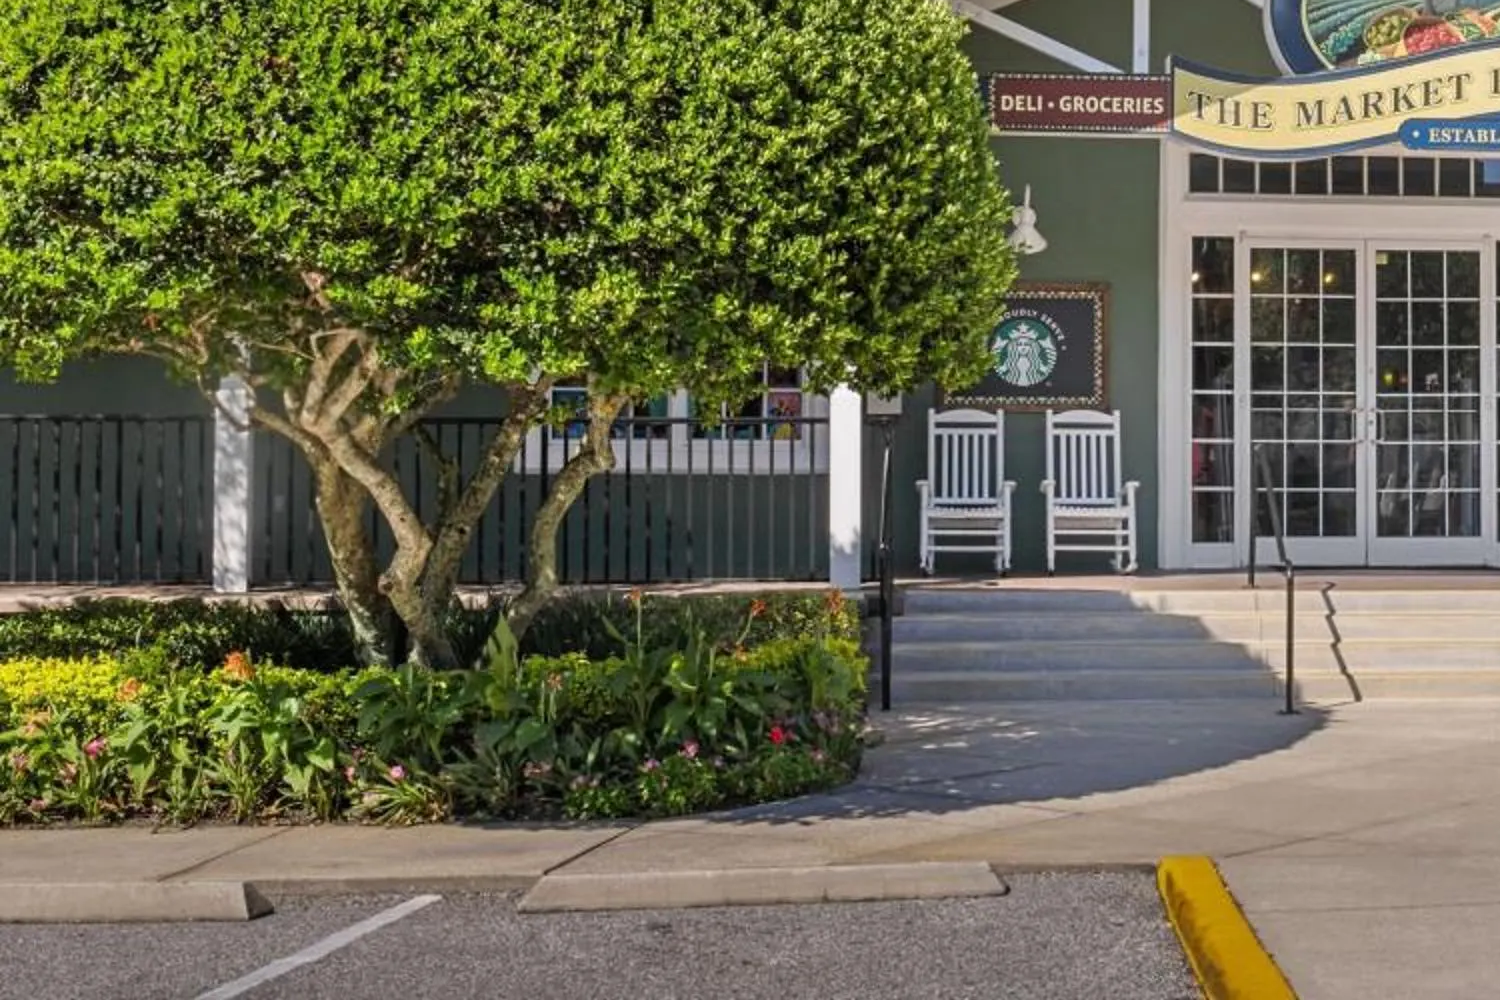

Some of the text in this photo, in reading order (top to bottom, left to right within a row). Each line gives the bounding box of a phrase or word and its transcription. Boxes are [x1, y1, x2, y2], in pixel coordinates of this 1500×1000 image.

[1000, 94, 1165, 115] DELI GROCERIES
[1187, 90, 1275, 131] THE
[1295, 72, 1472, 128] MARKET
